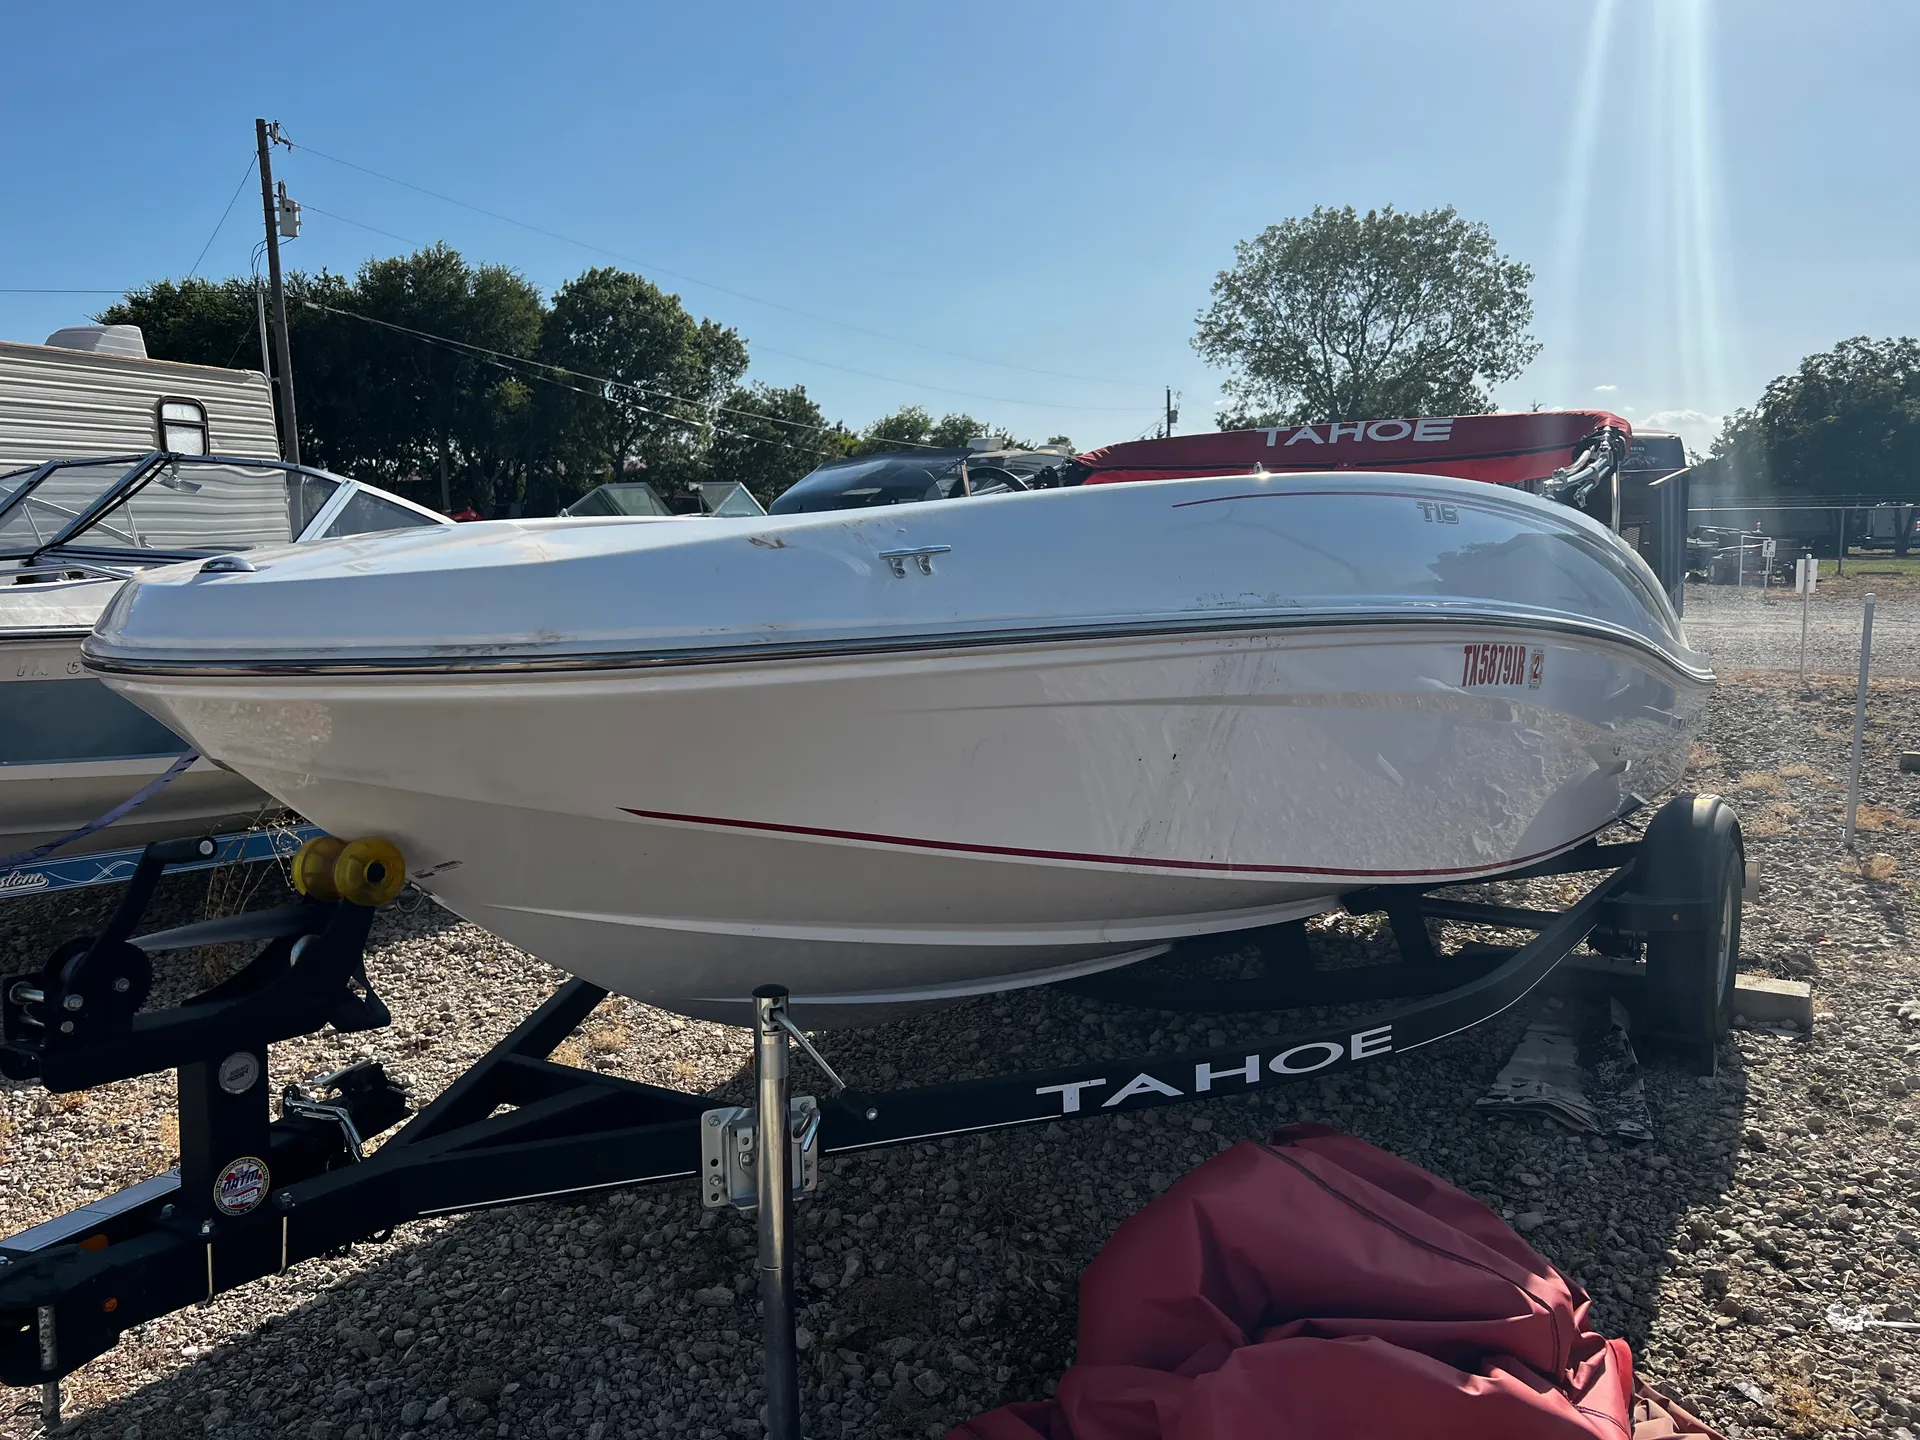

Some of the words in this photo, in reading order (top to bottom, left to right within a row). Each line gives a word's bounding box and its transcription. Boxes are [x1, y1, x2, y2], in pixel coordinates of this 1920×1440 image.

[1256, 418, 1454, 447] TAHOE
[1766, 541, 1773, 550] F
[1036, 1024, 1393, 1113] TAHOE
